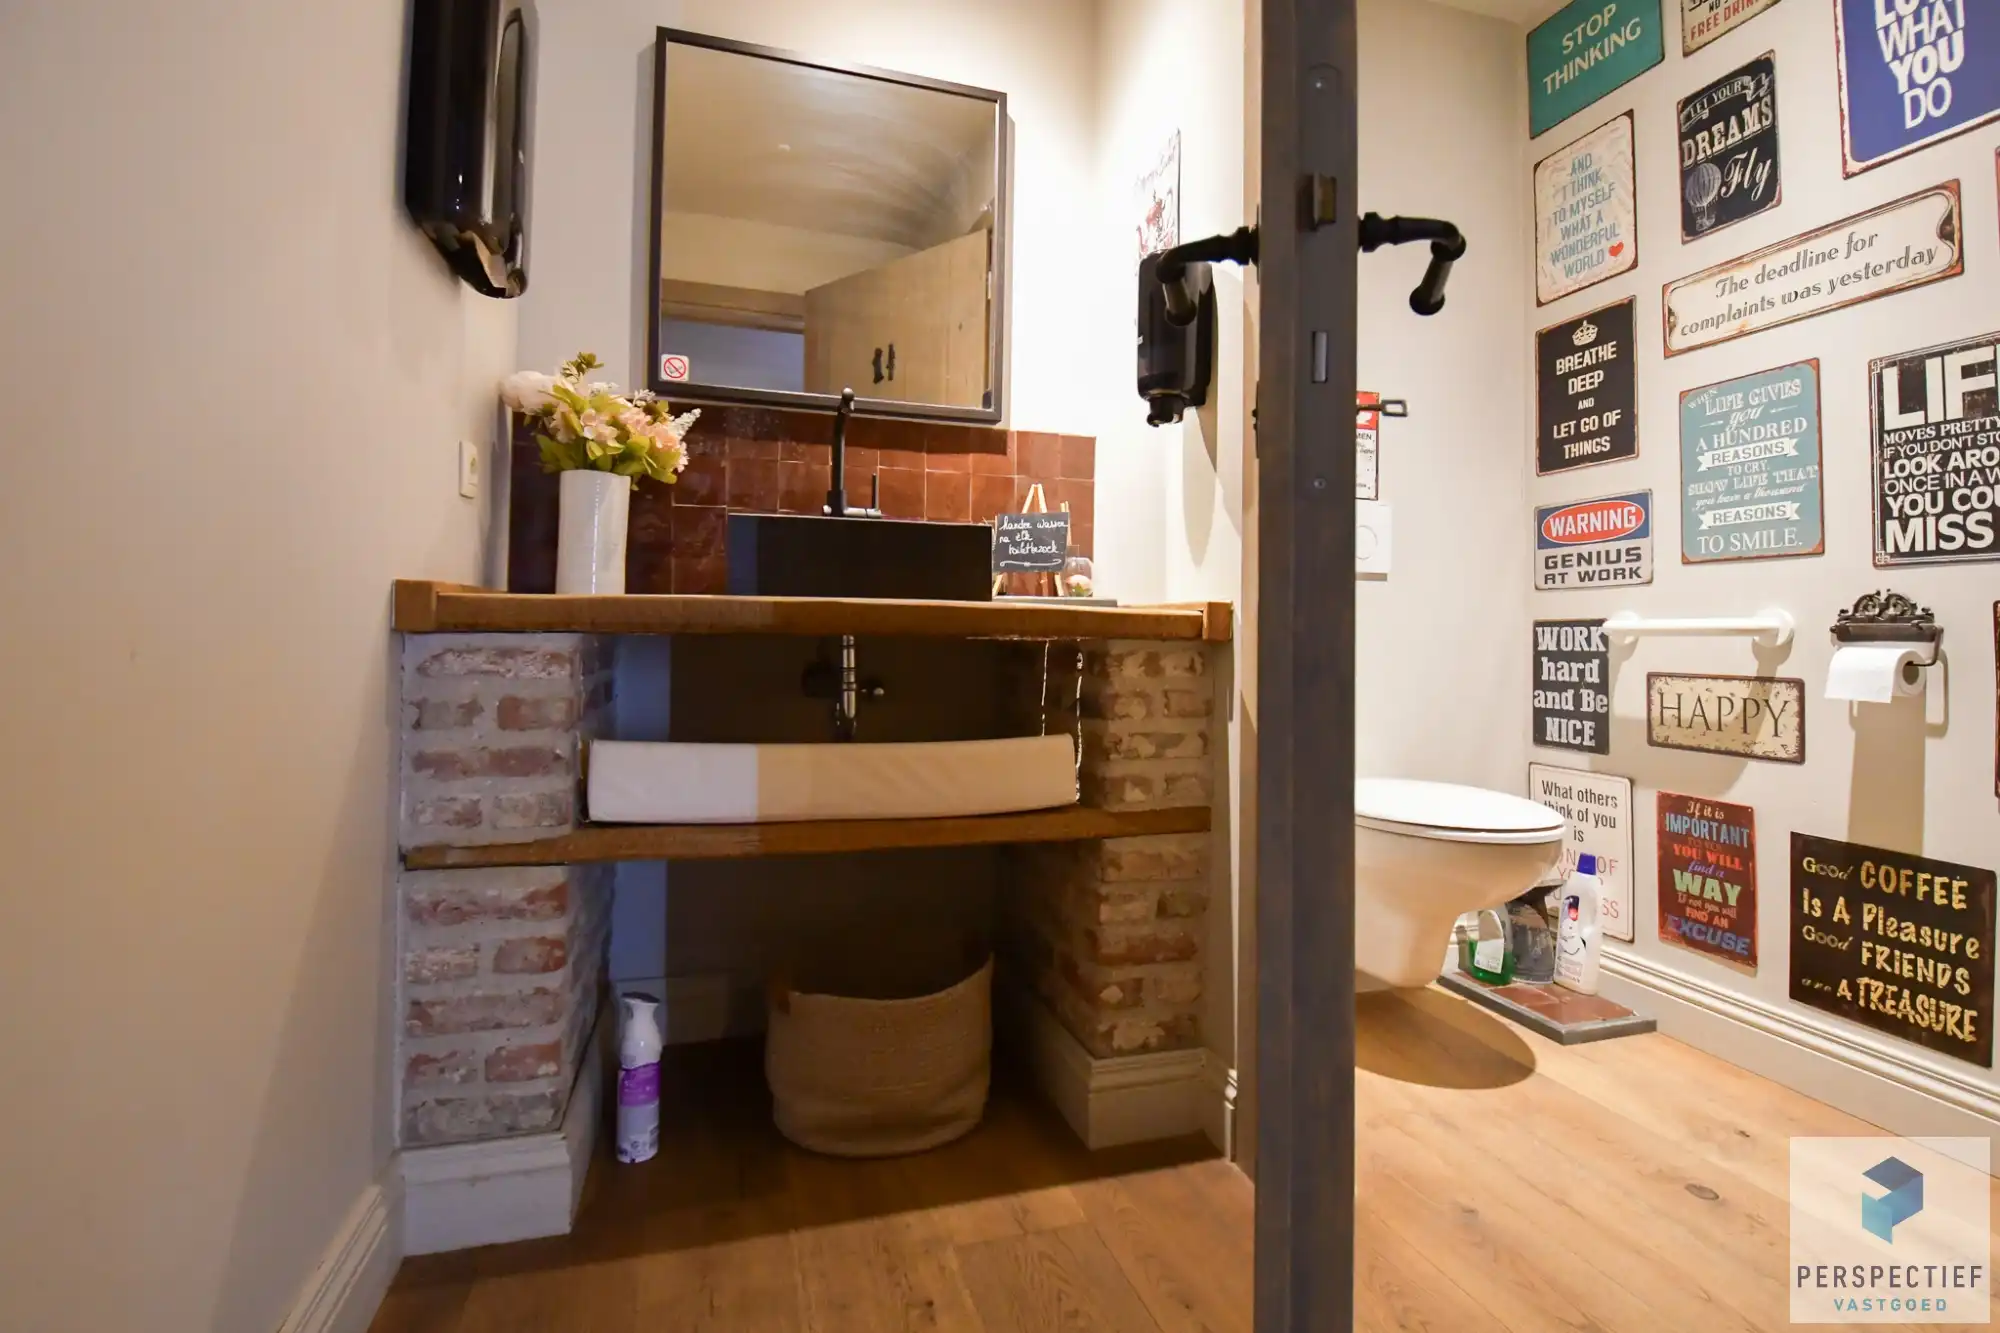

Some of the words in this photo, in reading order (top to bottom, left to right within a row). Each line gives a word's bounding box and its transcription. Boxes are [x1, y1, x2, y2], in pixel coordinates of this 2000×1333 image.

[1562, 3, 1616, 55] STOP
[1690, 12, 1720, 41] FREE
[1877, 0, 1965, 63] WHAT
[1543, 17, 1641, 95] THINKING
[1889, 29, 1965, 94] YOU
[1690, 96, 1708, 118] LET
[1712, 80, 1741, 103] YOUR
[1904, 77, 1952, 129] DO
[1682, 94, 1773, 169] DREAMS
[1571, 152, 1593, 177] AND
[1720, 147, 1772, 201] Fly
[1562, 185, 1567, 200] I
[1570, 167, 1602, 197] THINK
[1553, 207, 1566, 226] TO
[1569, 182, 1616, 217] MYSELF
[1560, 214, 1592, 241] WHAT
[1596, 209, 1603, 225] A
[1551, 222, 1620, 266] WONDERFUL
[1564, 249, 1605, 278] WORLD
[1715, 275, 1749, 299] The
[1755, 248, 1839, 285] deadline
[1844, 231, 1878, 259] for
[1680, 296, 1775, 336] complaints
[1781, 283, 1822, 305] was
[1827, 244, 1938, 295] yesterday
[1556, 341, 1617, 375] BREATHE
[1568, 370, 1604, 395] DEEP
[1705, 392, 1744, 416] LIFE
[1749, 378, 1802, 405] GIVES
[1882, 343, 2000, 431] LIF
[1578, 397, 1594, 410] AND
[1688, 388, 1718, 409] WHEN
[1553, 420, 1576, 439] LET
[1580, 415, 1599, 433] GO
[1603, 409, 1621, 427] OF
[1725, 405, 1764, 431] you
[1564, 435, 1611, 459] THINGS
[1696, 438, 1708, 452] A
[1712, 416, 1808, 449] HUNDRED
[1883, 424, 1936, 447] MOVES
[1884, 446, 1896, 459] IF
[1897, 442, 1927, 459] YOU
[1929, 434, 1974, 453] DON'T
[1711, 441, 1785, 465] REASONS
[1884, 453, 1942, 479] LOOK
[1688, 479, 1728, 496] SHOW
[1733, 473, 1768, 489] LIFE
[1772, 465, 1819, 484] THAT
[1728, 464, 1742, 476] TO
[1884, 474, 1941, 495] ONCE
[1946, 471, 1965, 488] IN
[1968, 469, 1984, 487] A
[1713, 504, 1786, 524] REASONS
[1886, 491, 1944, 518] YOU
[1550, 506, 1636, 538] WARNING
[1885, 511, 1994, 553] MISS
[1697, 534, 1724, 554] TO
[1729, 527, 1803, 552] SMILE.
[1544, 546, 1641, 570] GENIUS
[1544, 572, 1568, 585] AT
[1577, 566, 1642, 583] WORK
[1536, 627, 1606, 652] WORK
[1541, 656, 1600, 683] hard
[1533, 689, 1575, 711] and
[1579, 688, 1608, 714] Be
[1657, 692, 1791, 738] HAPPY
[1545, 717, 1596, 746] NICE
[1542, 780, 1572, 800] What
[1577, 788, 1618, 809] others
[1577, 808, 1589, 823] of
[1593, 812, 1616, 829] you
[1704, 805, 1712, 817] it
[1715, 807, 1724, 820] is
[1573, 826, 1584, 842] is
[1665, 812, 1750, 848] IMPORTANT
[1597, 856, 1618, 877] OF
[1673, 844, 1702, 860] YOU
[1707, 850, 1743, 870] WILL
[1688, 860, 1715, 875] find
[1716, 870, 1725, 878] a
[1673, 868, 1742, 906] WAY
[1860, 861, 1968, 910] COFFEE
[1686, 906, 1709, 922] FIND
[1713, 915, 1729, 929] AN
[1803, 888, 1822, 918] Is
[1832, 896, 1851, 925] A
[1862, 903, 1980, 960] Pleasure
[1667, 914, 1750, 956] EXCUSE
[1860, 940, 1971, 996] FRIENDS
[1836, 979, 1852, 1001] A
[1856, 977, 1978, 1043] TREASURE
